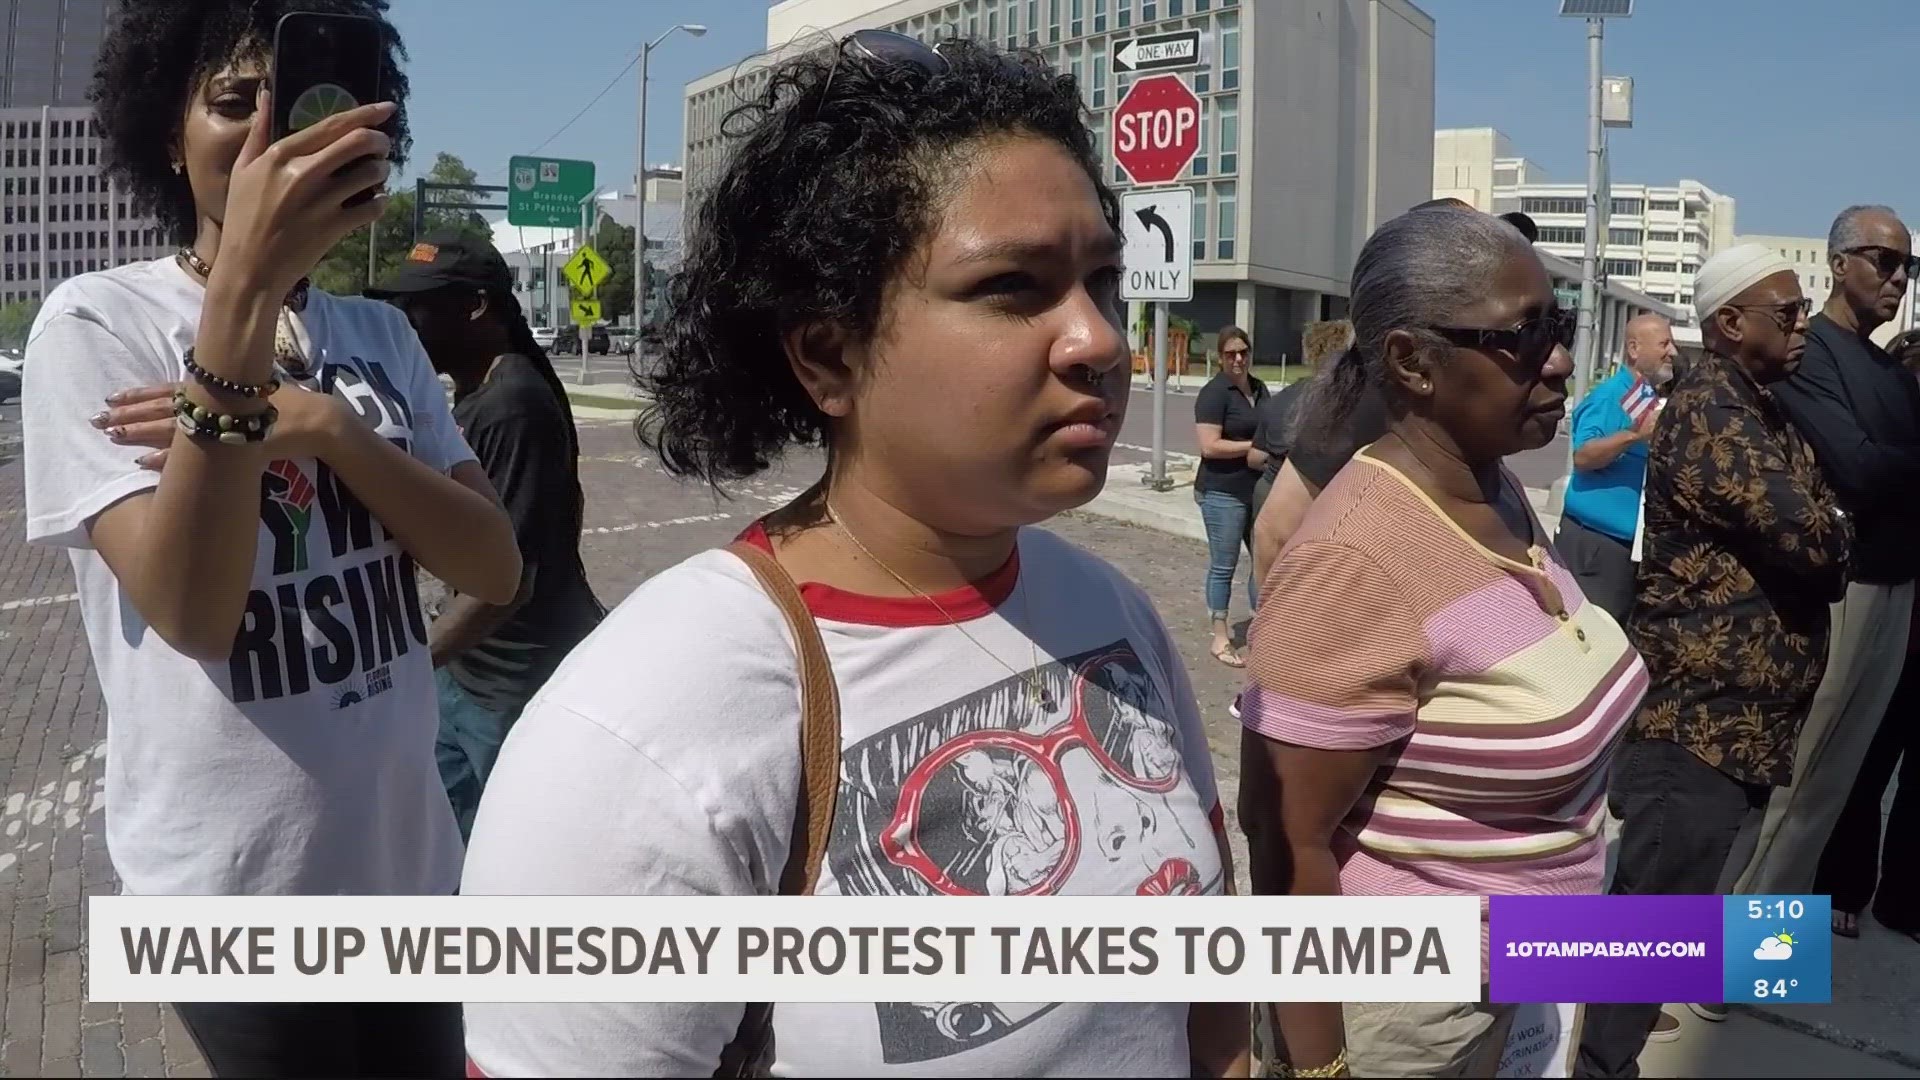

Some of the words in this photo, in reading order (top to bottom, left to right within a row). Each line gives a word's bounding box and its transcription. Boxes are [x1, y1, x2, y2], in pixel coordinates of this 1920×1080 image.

[1137, 45, 1160, 60] ONE
[1165, 41, 1190, 58] WAY
[1118, 107, 1195, 152] STOP
[519, 202, 530, 211] St
[533, 191, 575, 203] Brandon
[1131, 270, 1181, 290] ONLY
[367, 676, 393, 698] RISING
